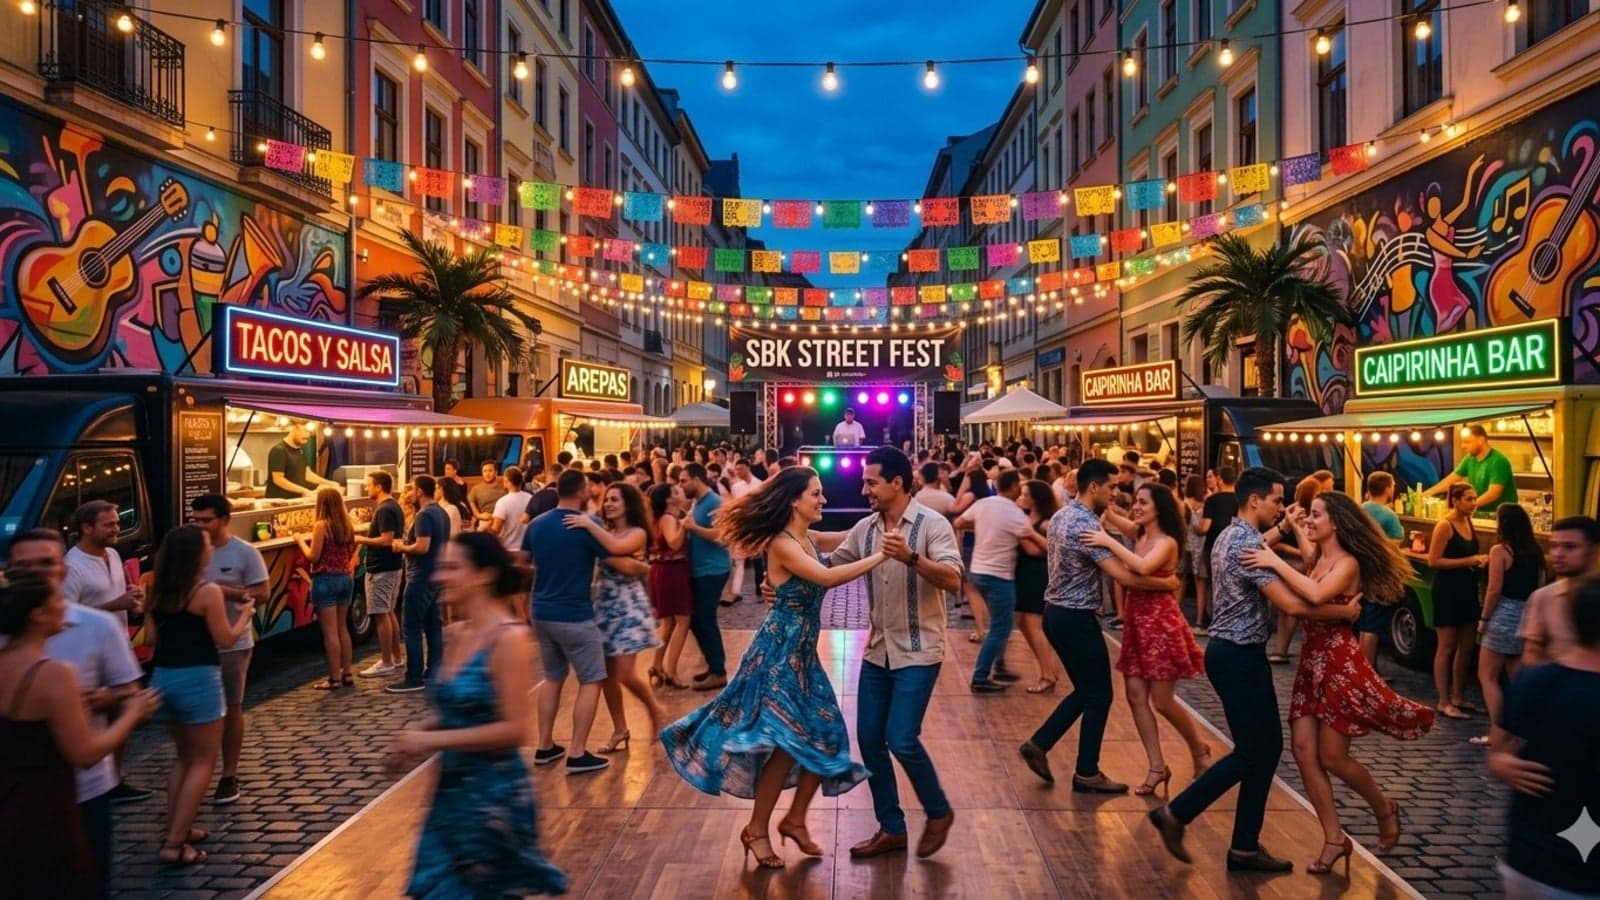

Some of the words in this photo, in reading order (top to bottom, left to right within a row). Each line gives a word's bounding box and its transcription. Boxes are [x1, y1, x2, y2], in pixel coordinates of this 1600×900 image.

[237, 321, 312, 367] TACOS
[318, 335, 333, 368] Y
[336, 338, 393, 375] SALSA
[746, 338, 792, 368] SBK
[797, 338, 883, 368] STREET
[889, 338, 945, 368] FEST
[1363, 343, 1480, 385] CAIPIRINHA
[1487, 334, 1545, 374] BAR
[566, 365, 627, 397] AREPAS
[1085, 371, 1143, 398] CAIPIRINHA
[1145, 367, 1171, 393] BAR
